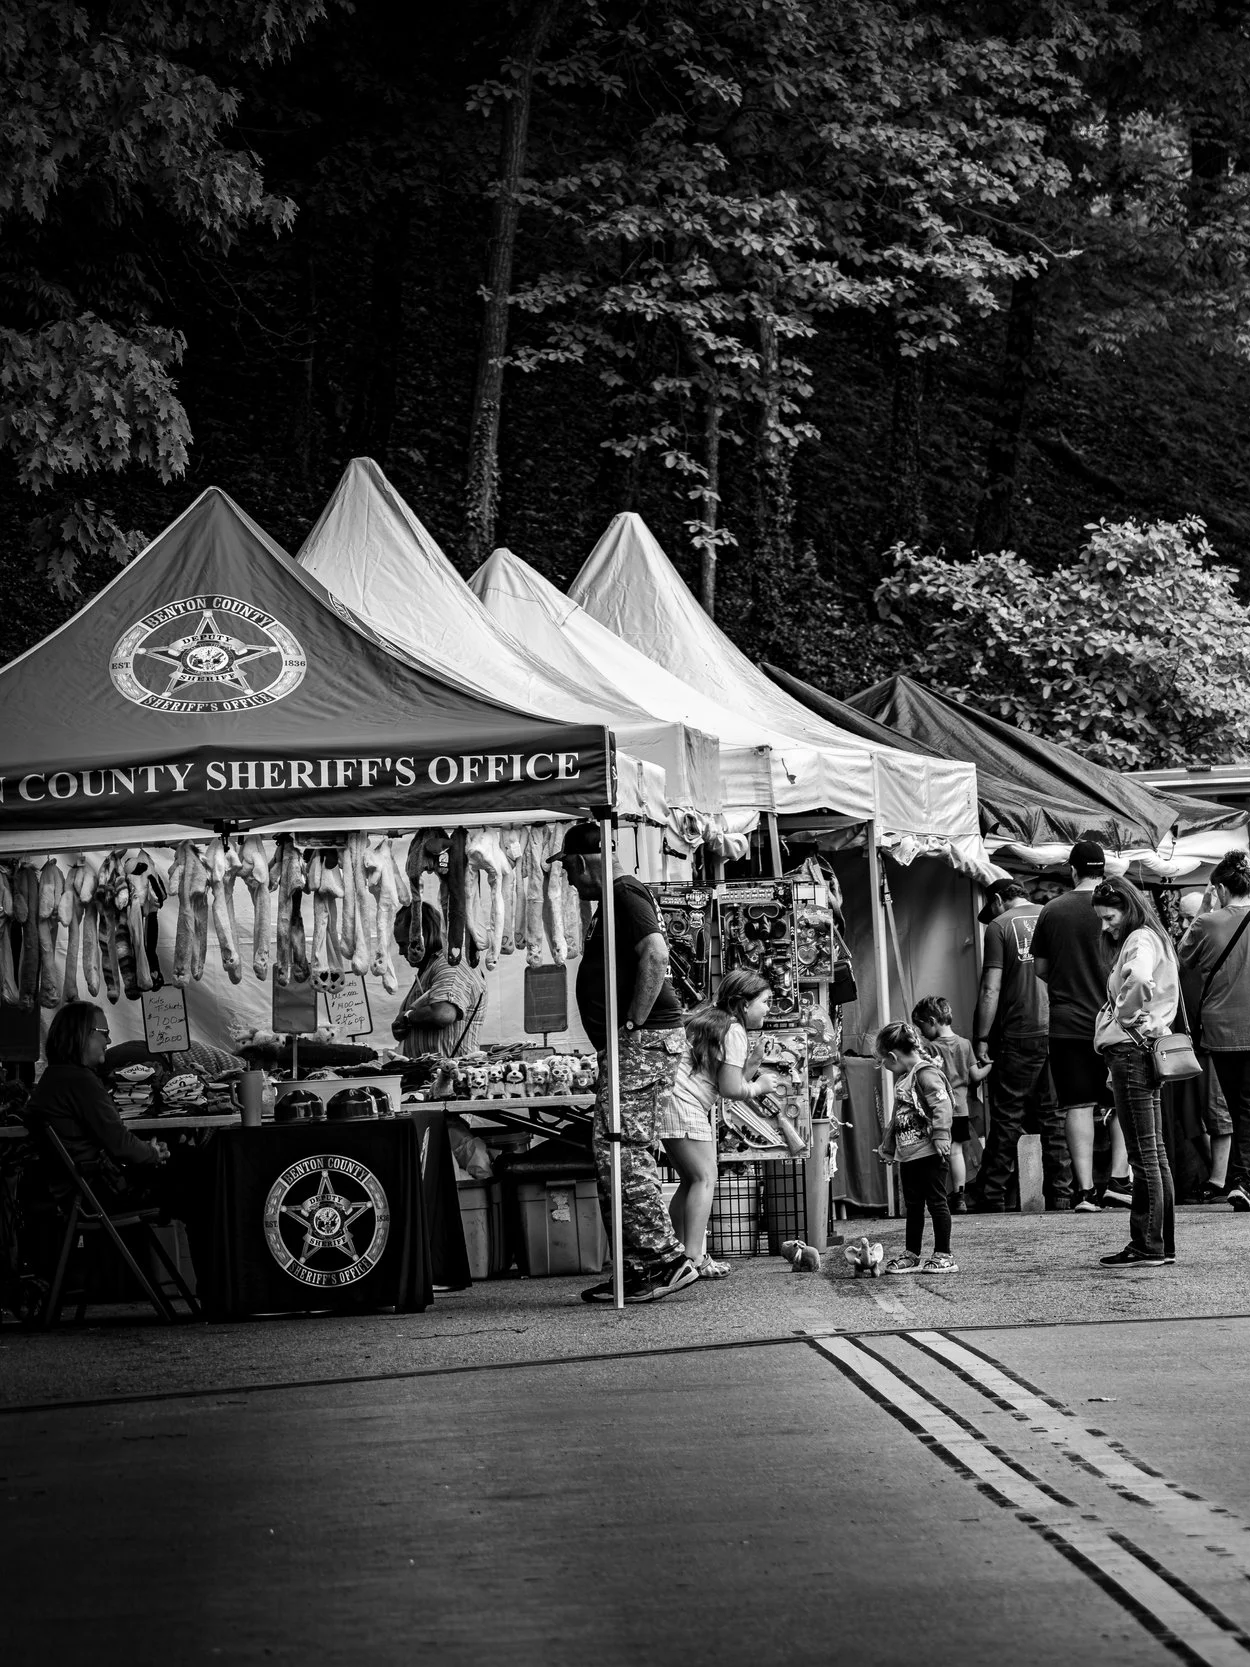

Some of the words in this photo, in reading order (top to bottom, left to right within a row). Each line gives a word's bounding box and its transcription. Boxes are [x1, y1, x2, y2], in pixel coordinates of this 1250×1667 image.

[149, 598, 207, 628] BENTON
[212, 597, 273, 627] COUNTY
[183, 634, 233, 645] DEPUTY
[111, 662, 131, 670] EST.
[284, 660, 306, 668] 1836
[179, 671, 236, 682] SHERIFF
[144, 696, 219, 712] SHERIFF'S
[224, 693, 272, 711] OFFICE
[18, 763, 195, 801] COUNTY
[206, 757, 417, 792] SHERIFF'S
[427, 752, 581, 786] OFFICE
[686, 893, 710, 901] FORCE
[283, 1157, 325, 1184] BENTON
[328, 1157, 369, 1181] COUNTY
[309, 1194, 345, 1204] DEPUTY
[309, 1237, 346, 1247] SHERIFF
[289, 1262, 338, 1285] SHERIFF'S
[340, 1258, 372, 1283] OFFICE
